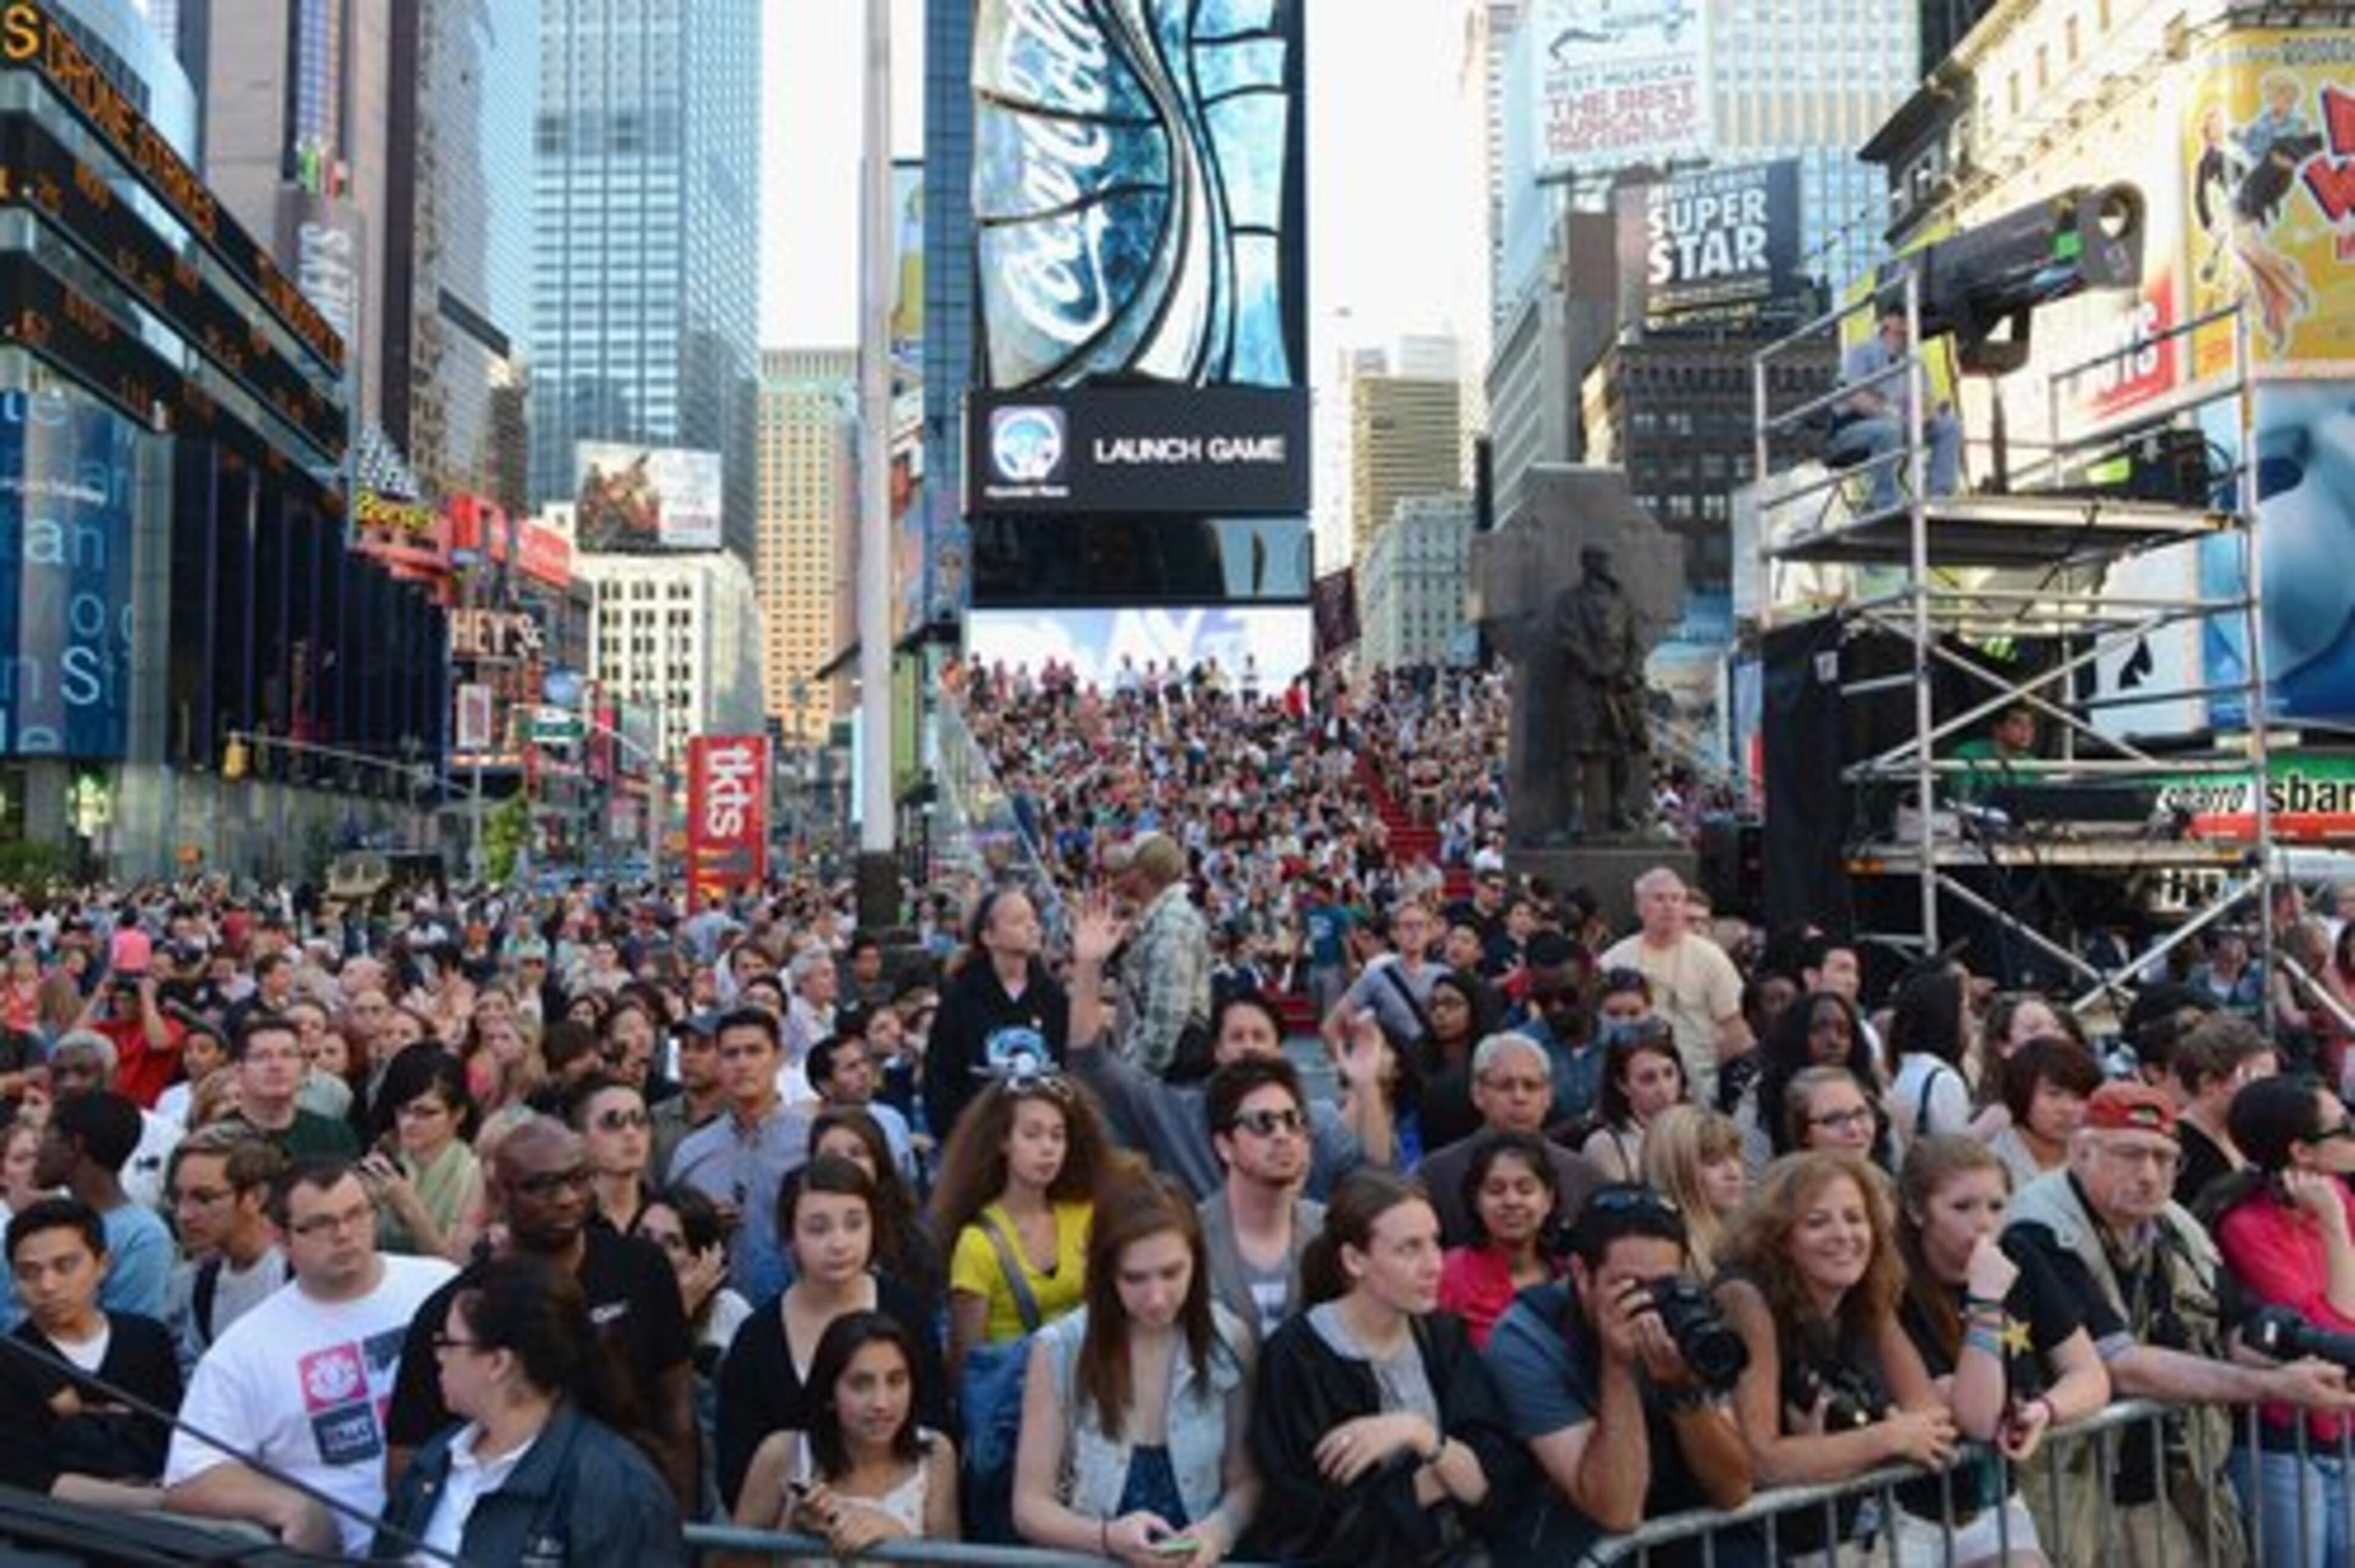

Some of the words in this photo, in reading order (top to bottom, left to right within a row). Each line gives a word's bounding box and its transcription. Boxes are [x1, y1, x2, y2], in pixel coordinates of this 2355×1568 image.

[1647, 187, 1770, 239] SUPER
[1647, 224, 1771, 285] STAR
[1092, 437, 1202, 464] LAUNCH
[1206, 434, 1287, 462] GAME
[705, 743, 756, 839] tkts
